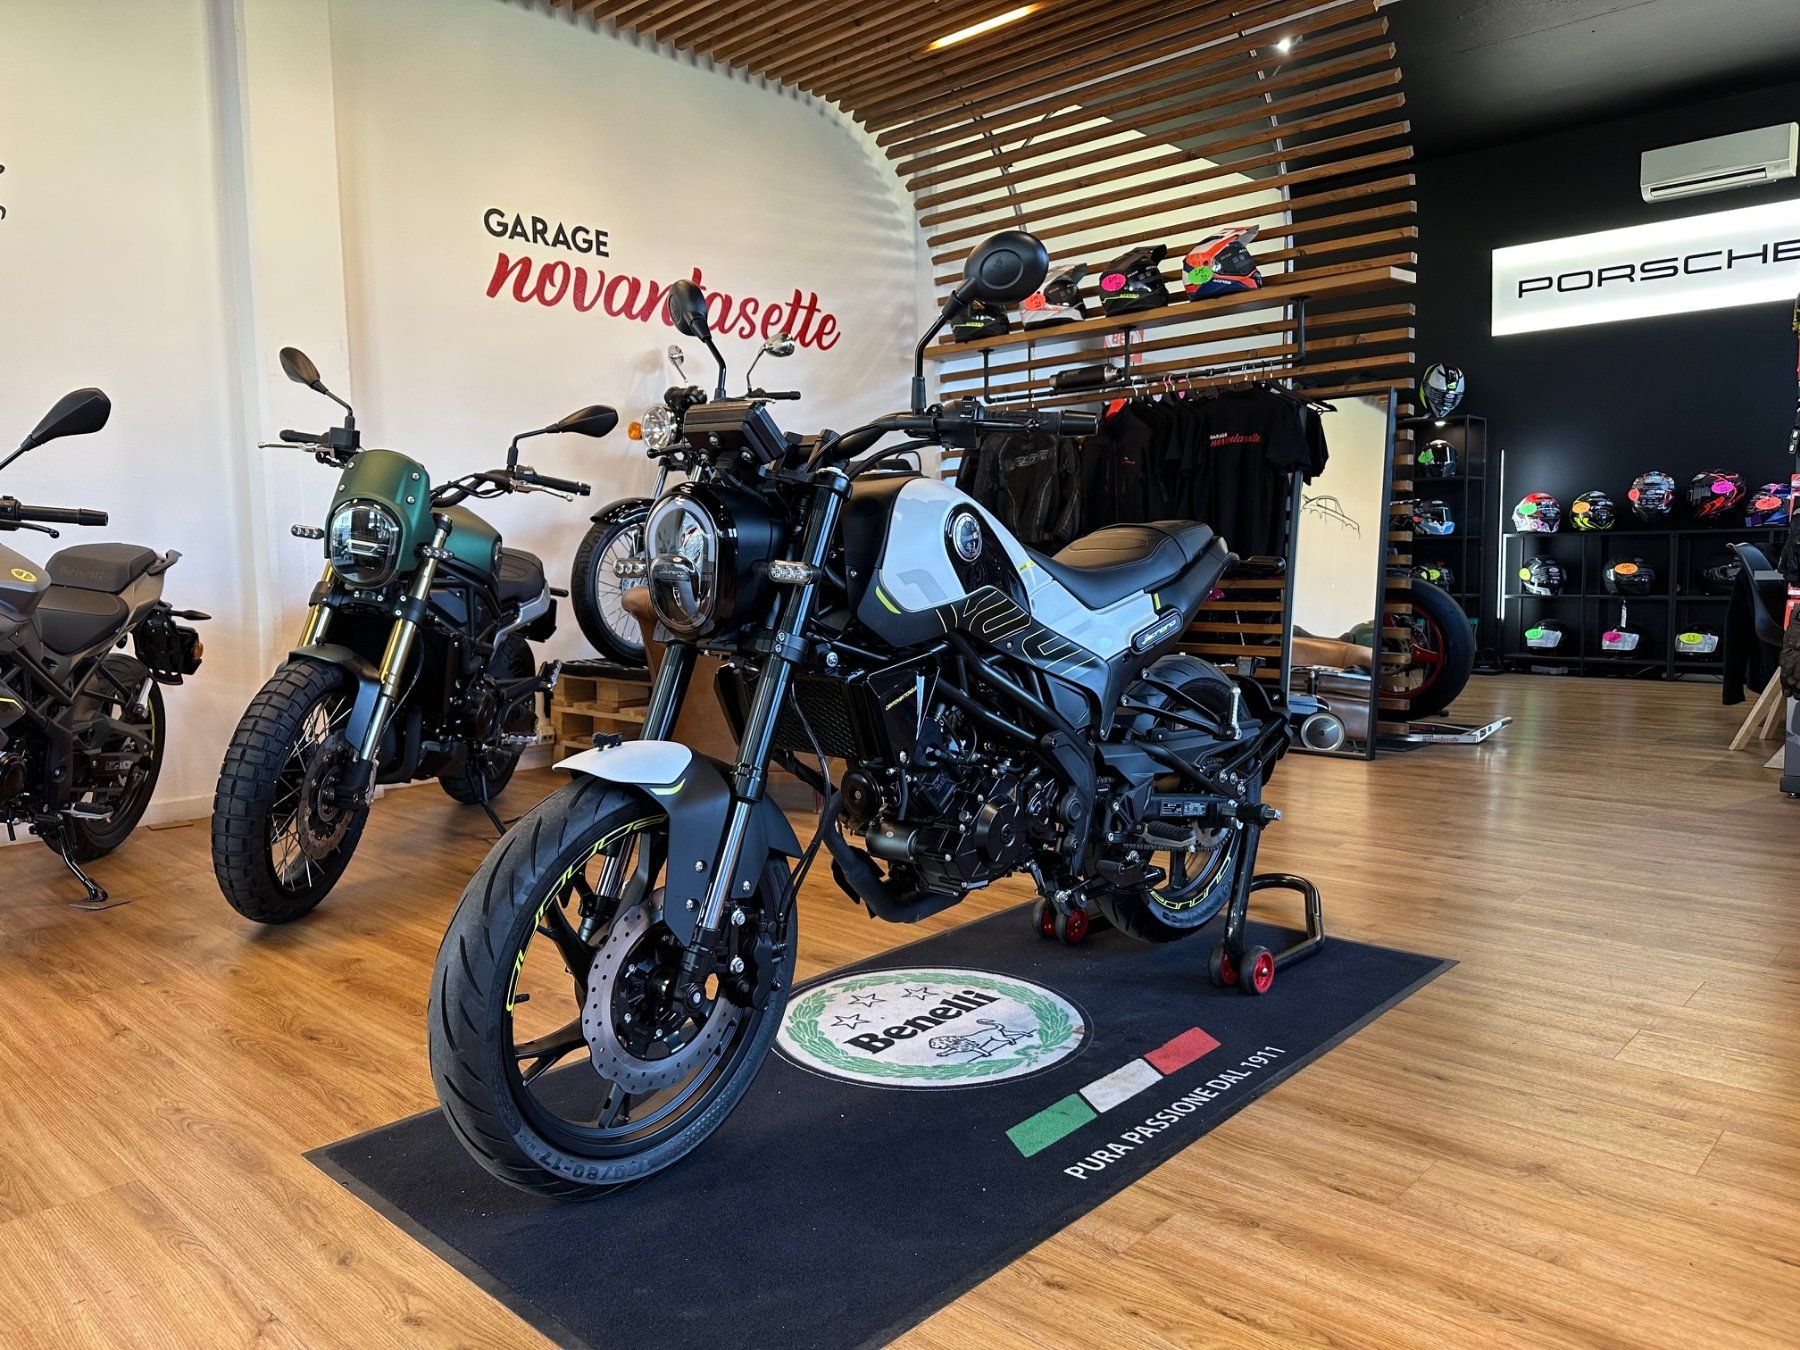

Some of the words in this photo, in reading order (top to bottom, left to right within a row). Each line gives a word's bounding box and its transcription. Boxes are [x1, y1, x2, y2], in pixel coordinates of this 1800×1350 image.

[483, 207, 610, 257] GARAGE
[1518, 238, 1800, 299] PORSCHE
[843, 989, 1002, 1055] Benelli
[1063, 1142, 1135, 1180] PURA
[1121, 1087, 1220, 1145] PASSIONE
[1205, 1069, 1253, 1091] DAL
[1240, 1046, 1286, 1069] 1911
